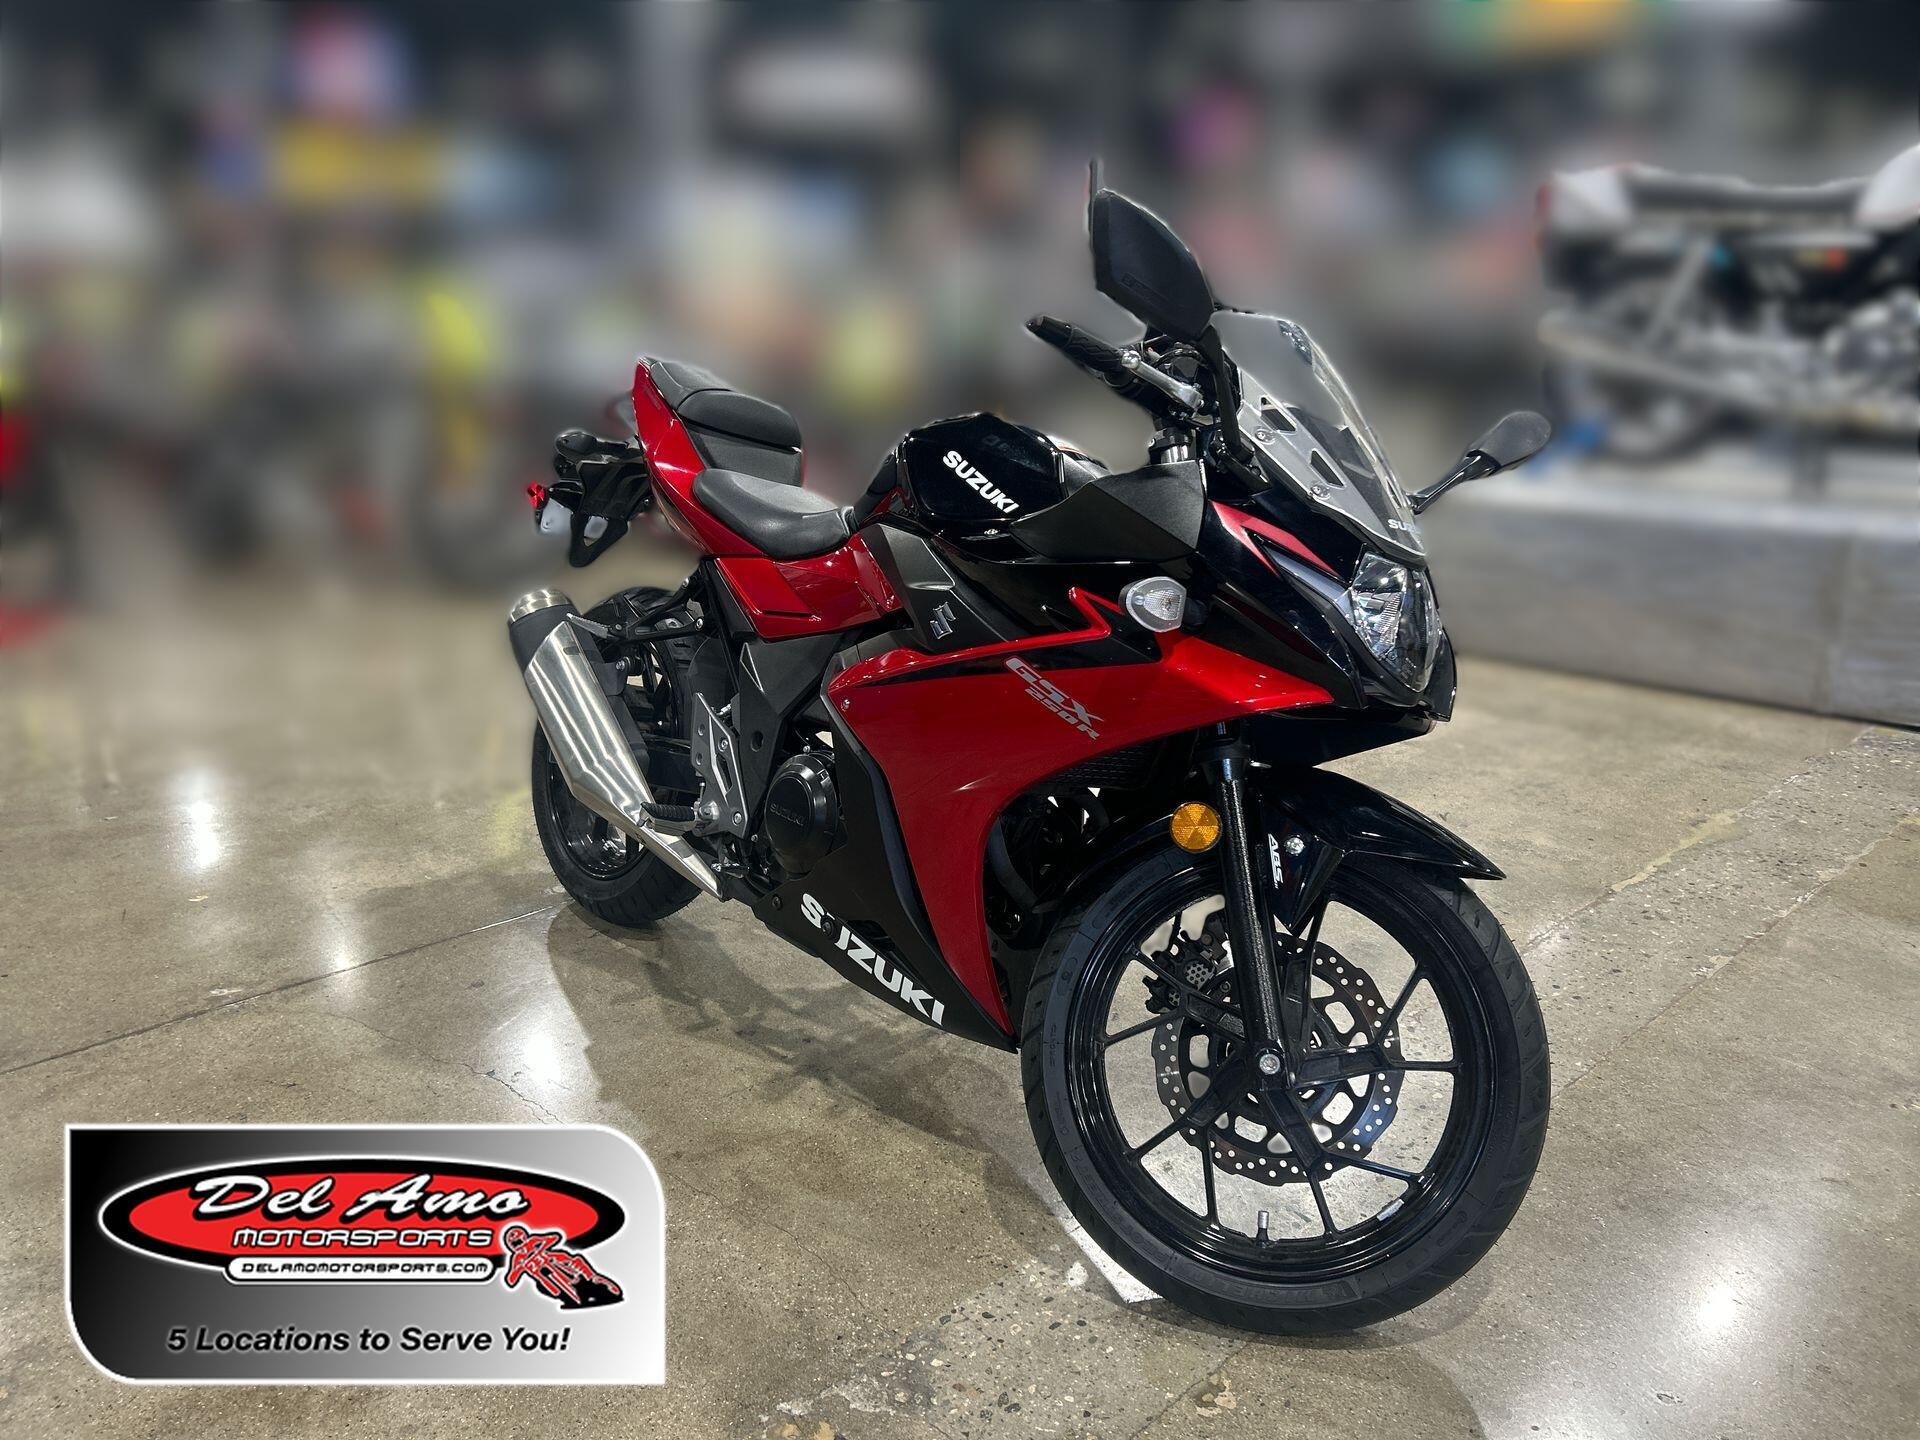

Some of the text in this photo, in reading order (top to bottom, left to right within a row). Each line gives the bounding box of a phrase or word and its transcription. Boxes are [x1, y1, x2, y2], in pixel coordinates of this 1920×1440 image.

[943, 450, 1020, 513] SUZUKI
[1005, 657, 1105, 728] GSX
[1267, 833, 1284, 884] ABS
